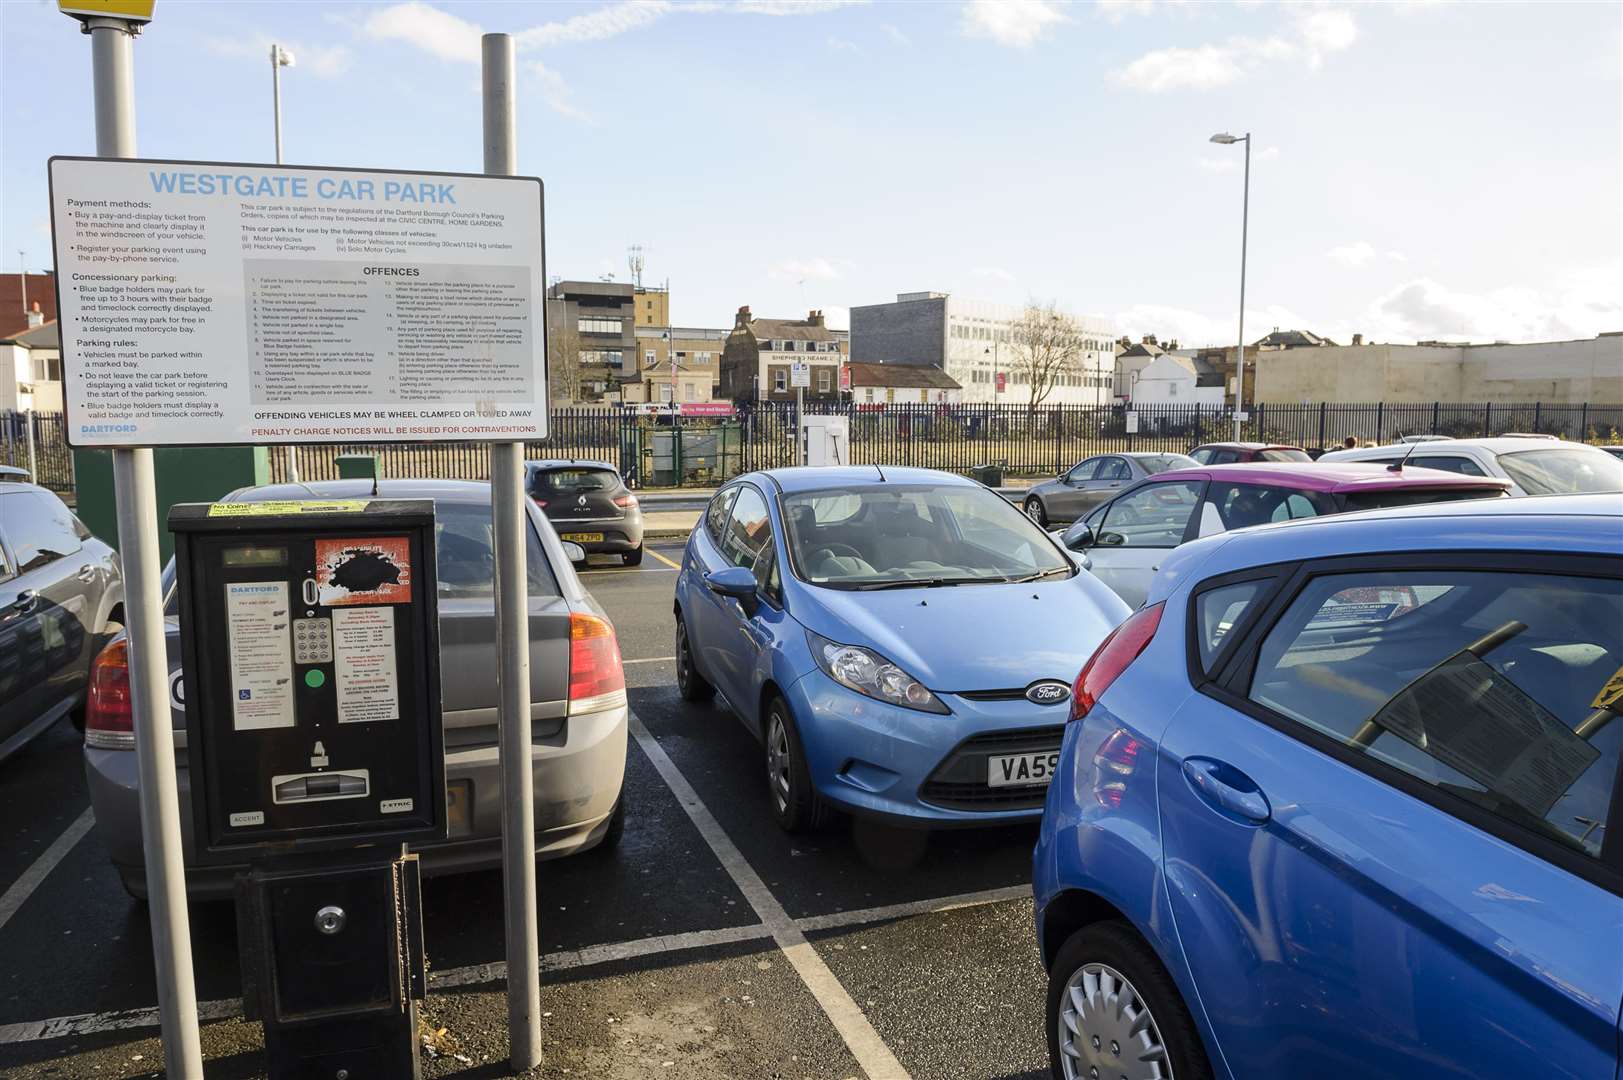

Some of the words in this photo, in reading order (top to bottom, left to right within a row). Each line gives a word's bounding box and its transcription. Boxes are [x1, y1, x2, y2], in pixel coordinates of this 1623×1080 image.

[150, 171, 307, 198] WESTGATE
[316, 177, 374, 201] CAR
[384, 181, 455, 204] PARK
[66, 198, 107, 207] Payment
[109, 200, 151, 208] methods:
[74, 210, 90, 219] Buy
[98, 212, 163, 221] pay-and-display
[164, 213, 186, 221] ticket
[76, 244, 109, 253] Register
[92, 254, 148, 263] pay-by-phone
[362, 266, 419, 276] OFFENCES
[71, 273, 139, 282] Concessionary
[140, 274, 176, 283] parking:
[175, 287, 192, 295] park
[188, 296, 212, 304] badge
[134, 326, 178, 334] motorcycle
[76, 338, 111, 347] Parking
[84, 371, 97, 379] Do
[97, 370, 111, 379] not
[120, 389, 129, 397] of
[106, 401, 132, 409] badge
[254, 411, 306, 419] OFFENDING
[476, 409, 507, 418] TOWED
[79, 424, 137, 433] DARTFORD
[251, 428, 291, 436] PENALTY
[293, 427, 330, 435] CHARGE
[332, 427, 371, 435] NOTICES
[461, 425, 536, 433] CONTRAVENTIONS
[1038, 686, 1062, 699] Ford
